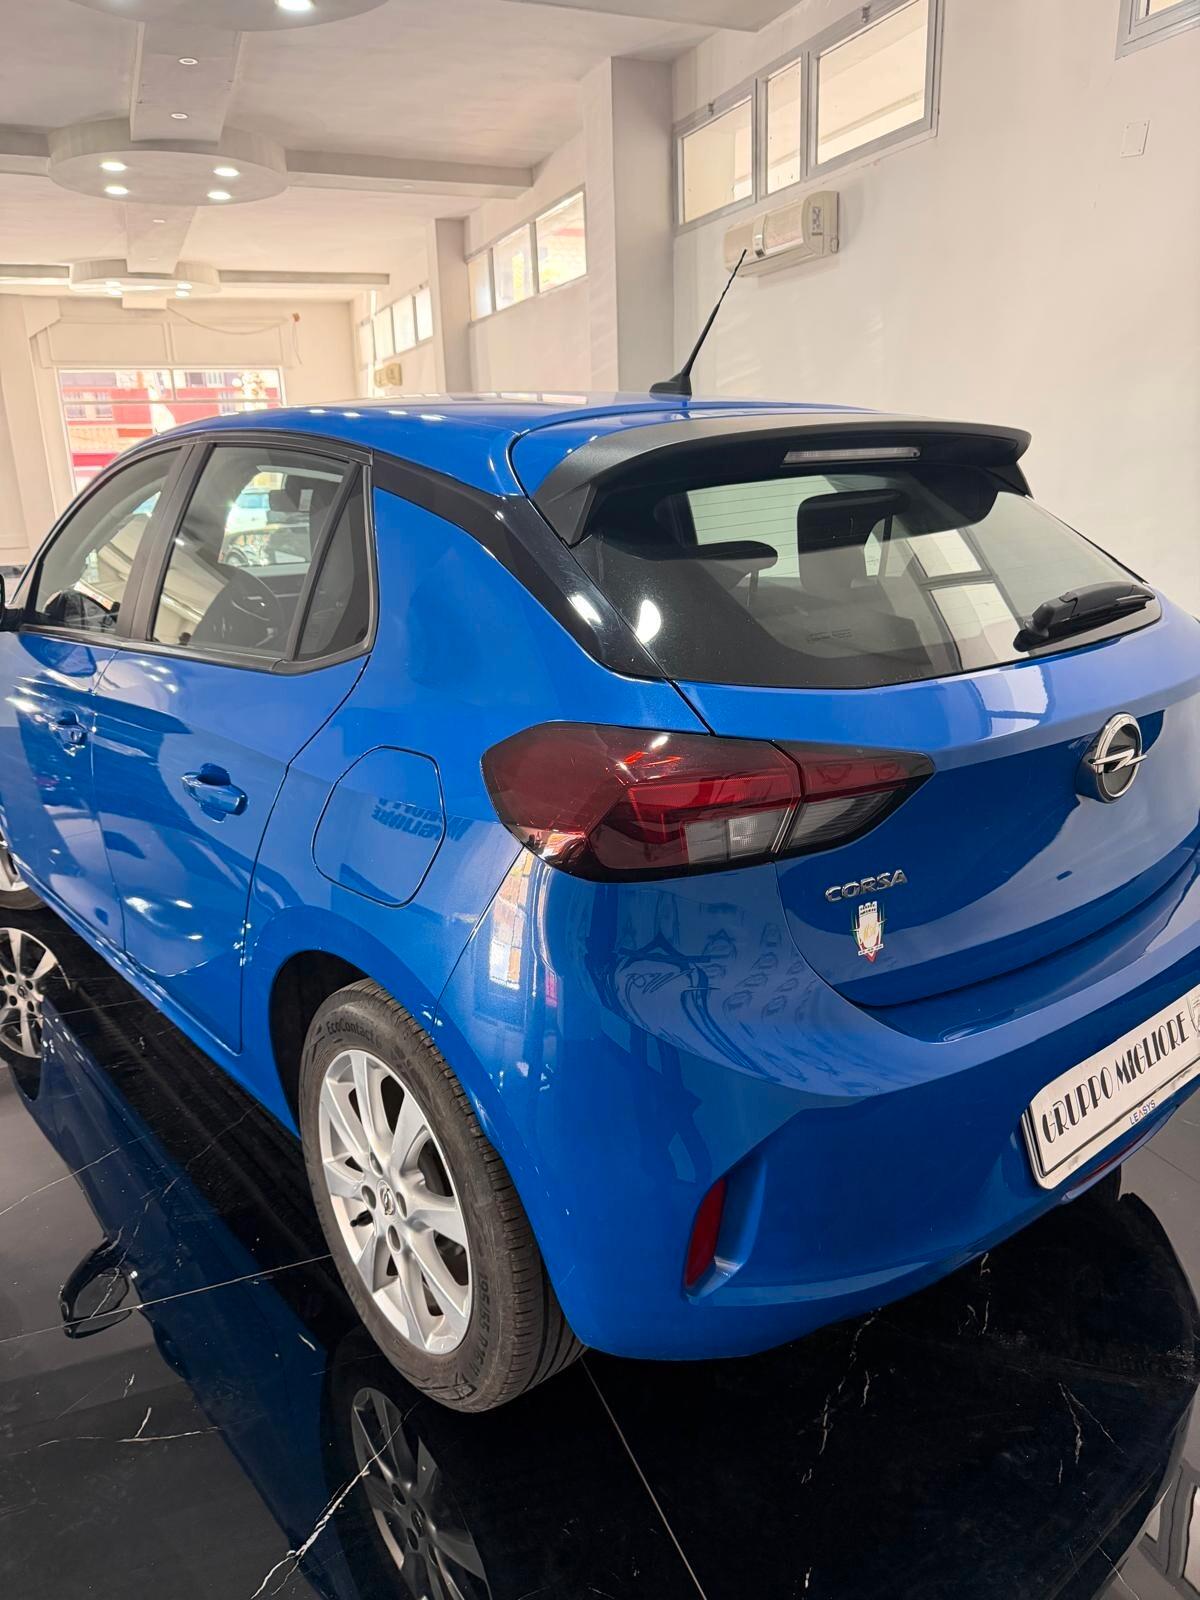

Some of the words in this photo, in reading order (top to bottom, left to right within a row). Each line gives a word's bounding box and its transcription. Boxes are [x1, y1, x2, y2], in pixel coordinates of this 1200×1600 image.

[825, 869, 907, 902] CORSA
[326, 1018, 376, 1045] EcoContact
[1041, 1066, 1113, 1143] GRUPPO
[1114, 1011, 1189, 1091] MIGLIORE
[1129, 1099, 1156, 1125] LEASYS
